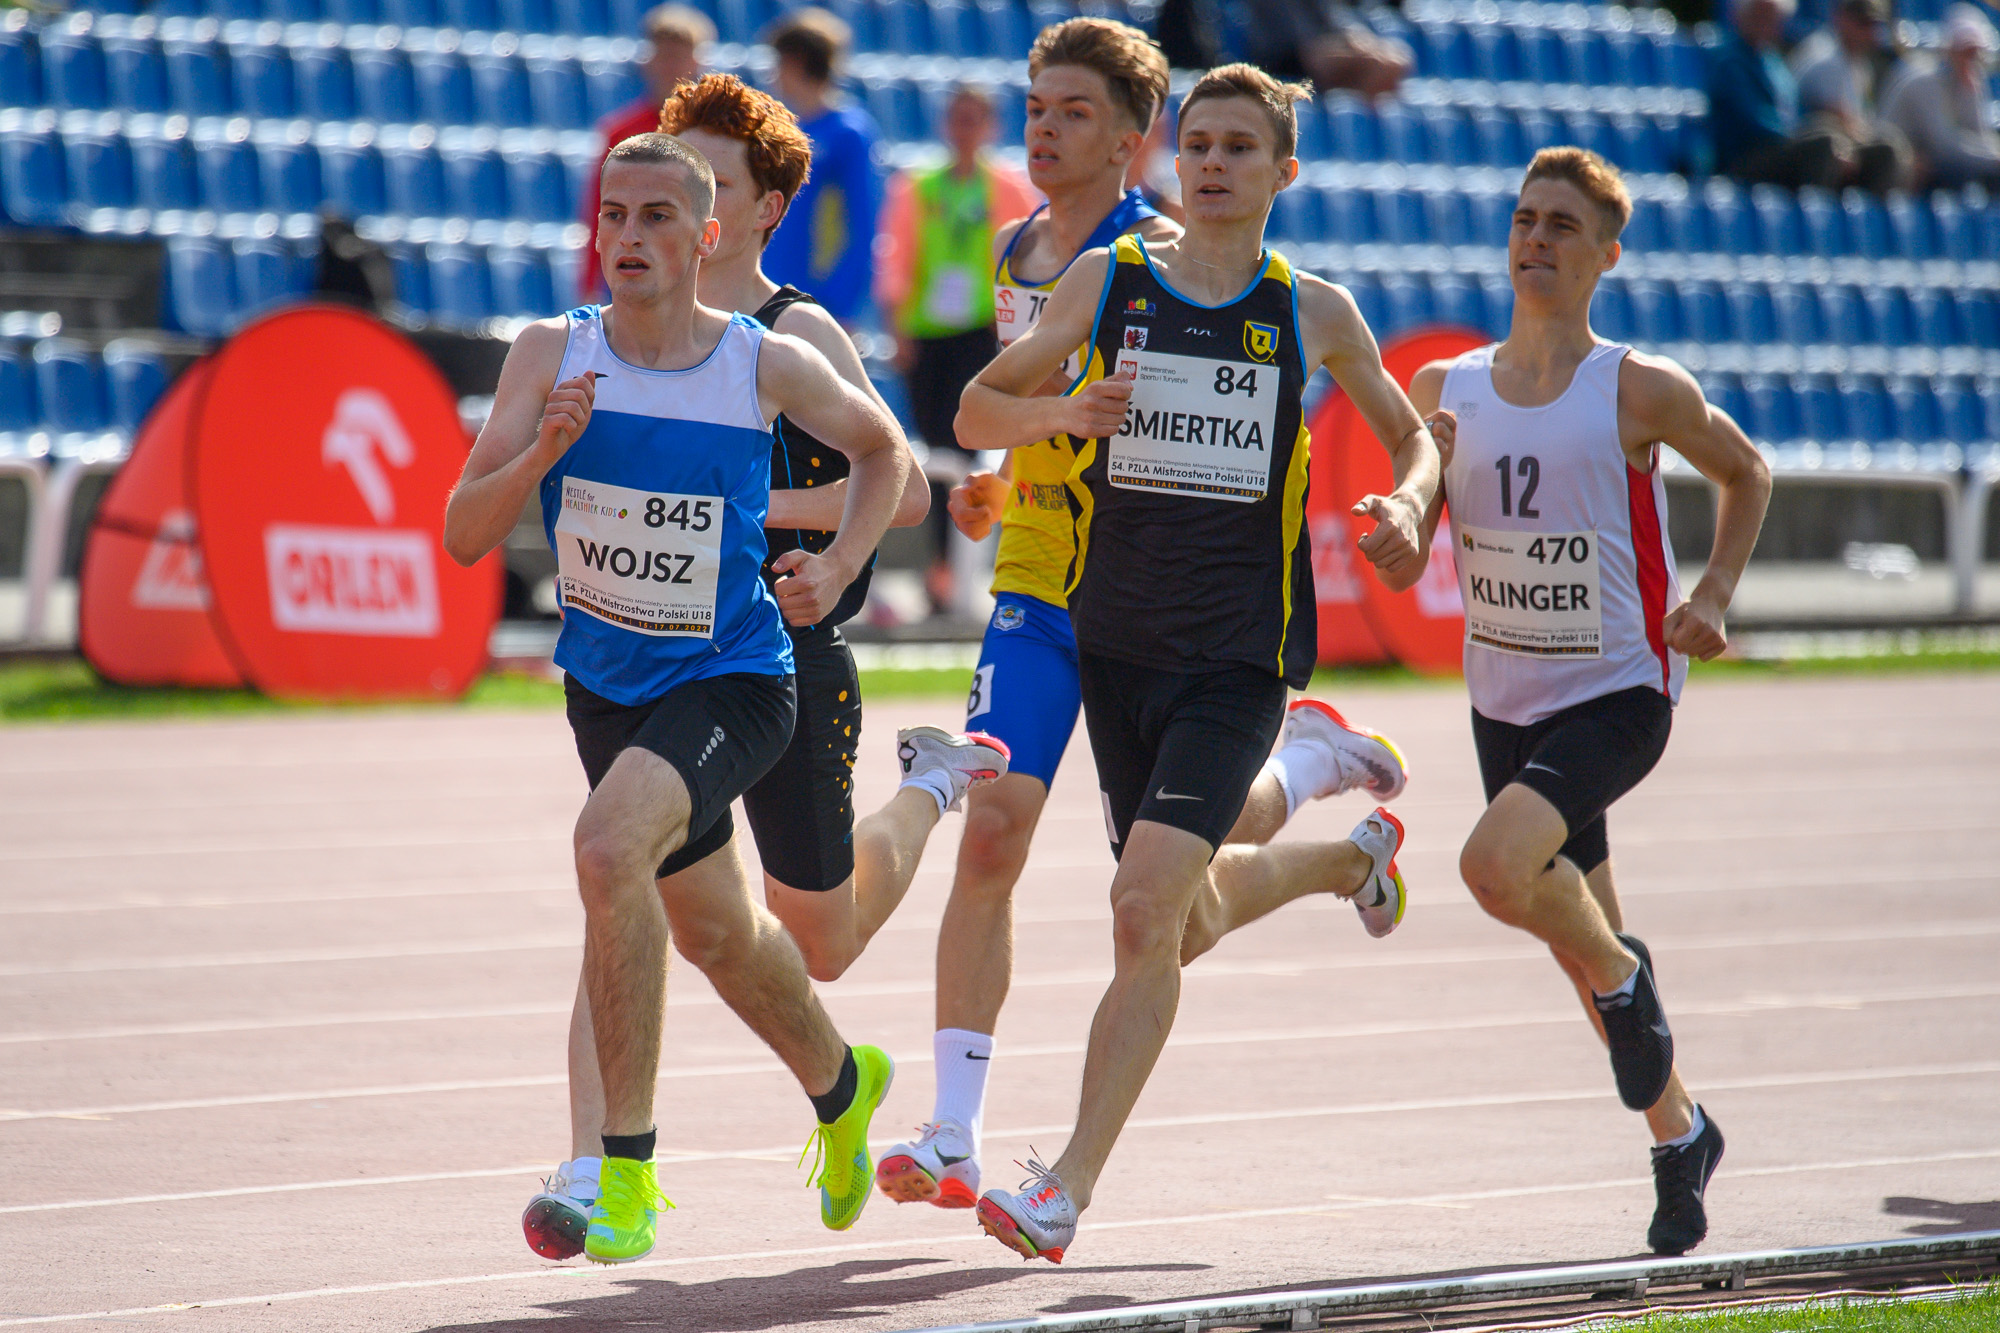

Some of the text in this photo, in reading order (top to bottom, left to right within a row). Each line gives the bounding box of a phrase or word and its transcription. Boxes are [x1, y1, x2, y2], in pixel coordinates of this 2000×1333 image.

[1140, 374, 1159, 382] Sportu
[1163, 376, 1188, 384] Turystyki
[1141, 365, 1176, 375] Ministerstwo
[1214, 366, 1257, 398] 84
[1118, 402, 1264, 451] ŚMIERTKA
[1112, 462, 1265, 486] 54. PZLA Mistrzostwa Polski U18
[1112, 476, 1261, 497] BIELSKO-BIAŁA 15-17.07.2022
[1495, 456, 1540, 519] 12
[566, 499, 617, 518] HEALTHIER KIDS
[587, 493, 595, 502] for
[644, 497, 711, 532] 845
[576, 538, 695, 584] WOJSZ
[1527, 537, 1589, 564] 470
[286, 550, 419, 611] ORLEN
[1471, 574, 1591, 612] KLINGER
[564, 582, 712, 620] 54. PZLA Mistrzostwa Polski U18
[567, 596, 708, 632] BIELSKO-BIAŁA 15-17.07.2022
[1500, 630, 1548, 643] Mistrzostwa
[1551, 634, 1578, 643] Polski
[1581, 633, 1599, 643] U18
